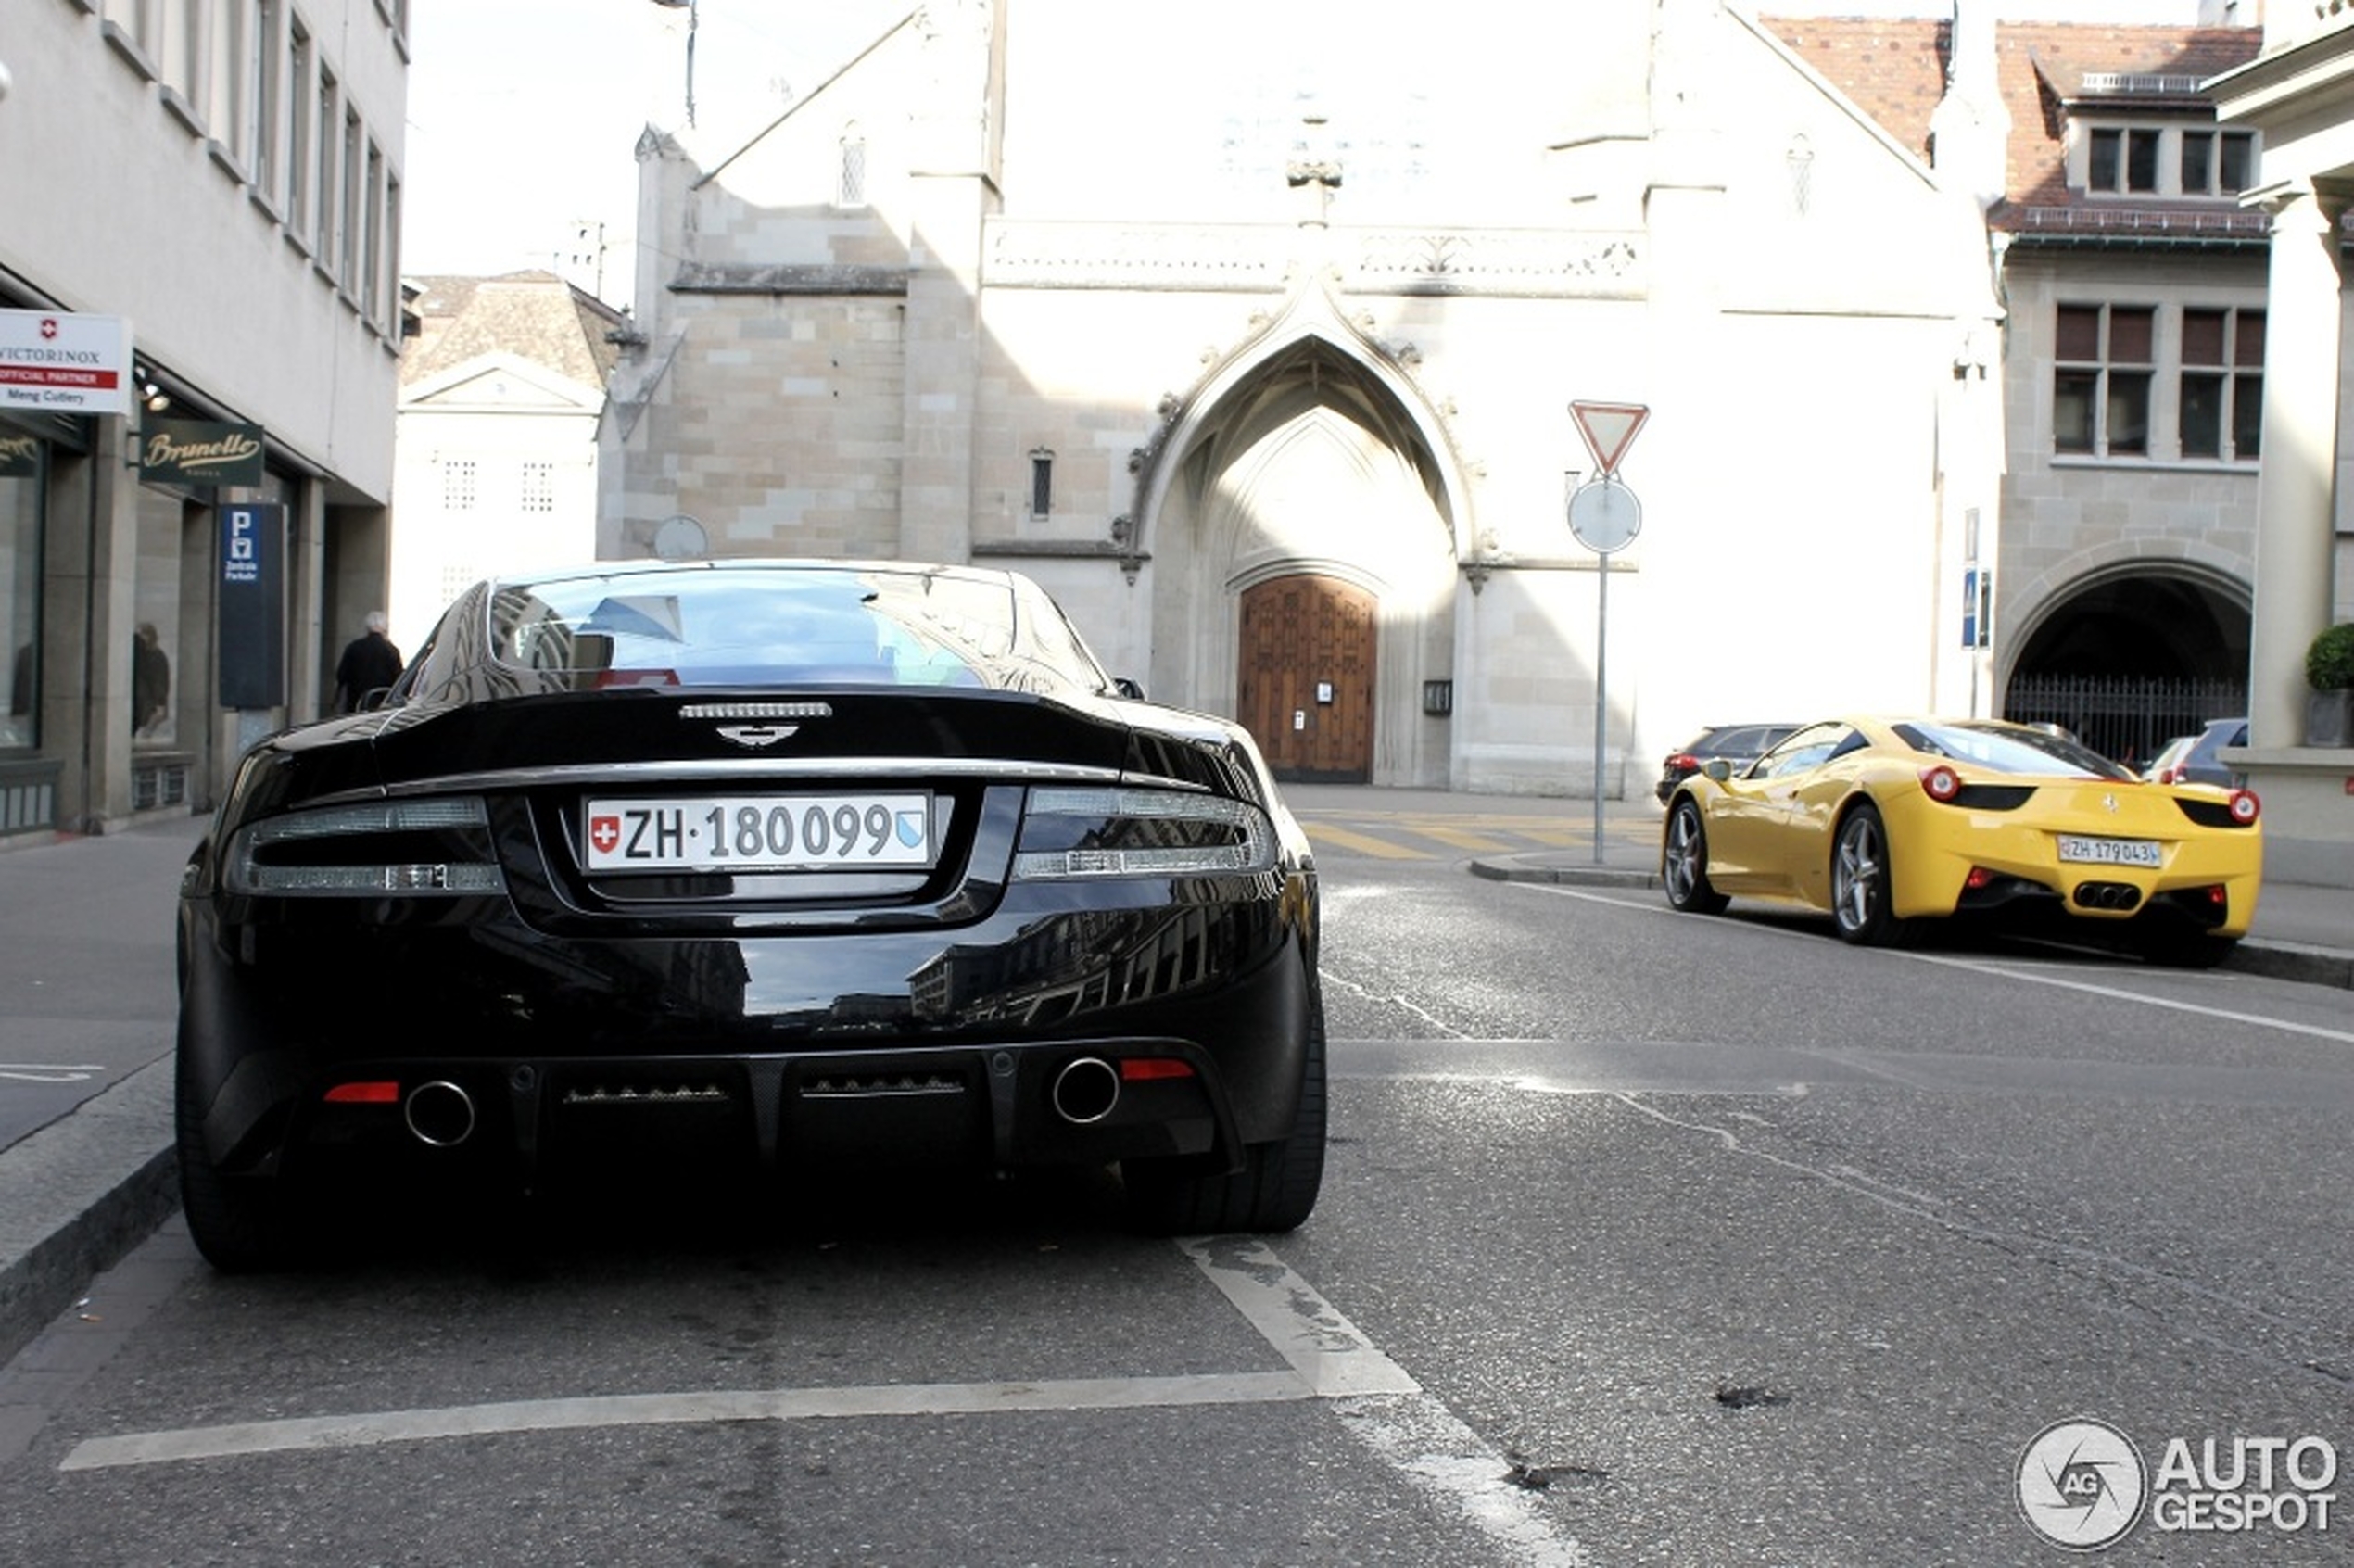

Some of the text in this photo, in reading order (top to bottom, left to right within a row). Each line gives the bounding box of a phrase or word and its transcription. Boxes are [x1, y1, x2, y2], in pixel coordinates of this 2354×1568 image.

[47, 371, 97, 385] PARTNER
[8, 389, 85, 405] Meng Cutlery
[144, 434, 259, 468] Brunello
[232, 512, 251, 537] P
[2095, 843, 2148, 862] 179043
